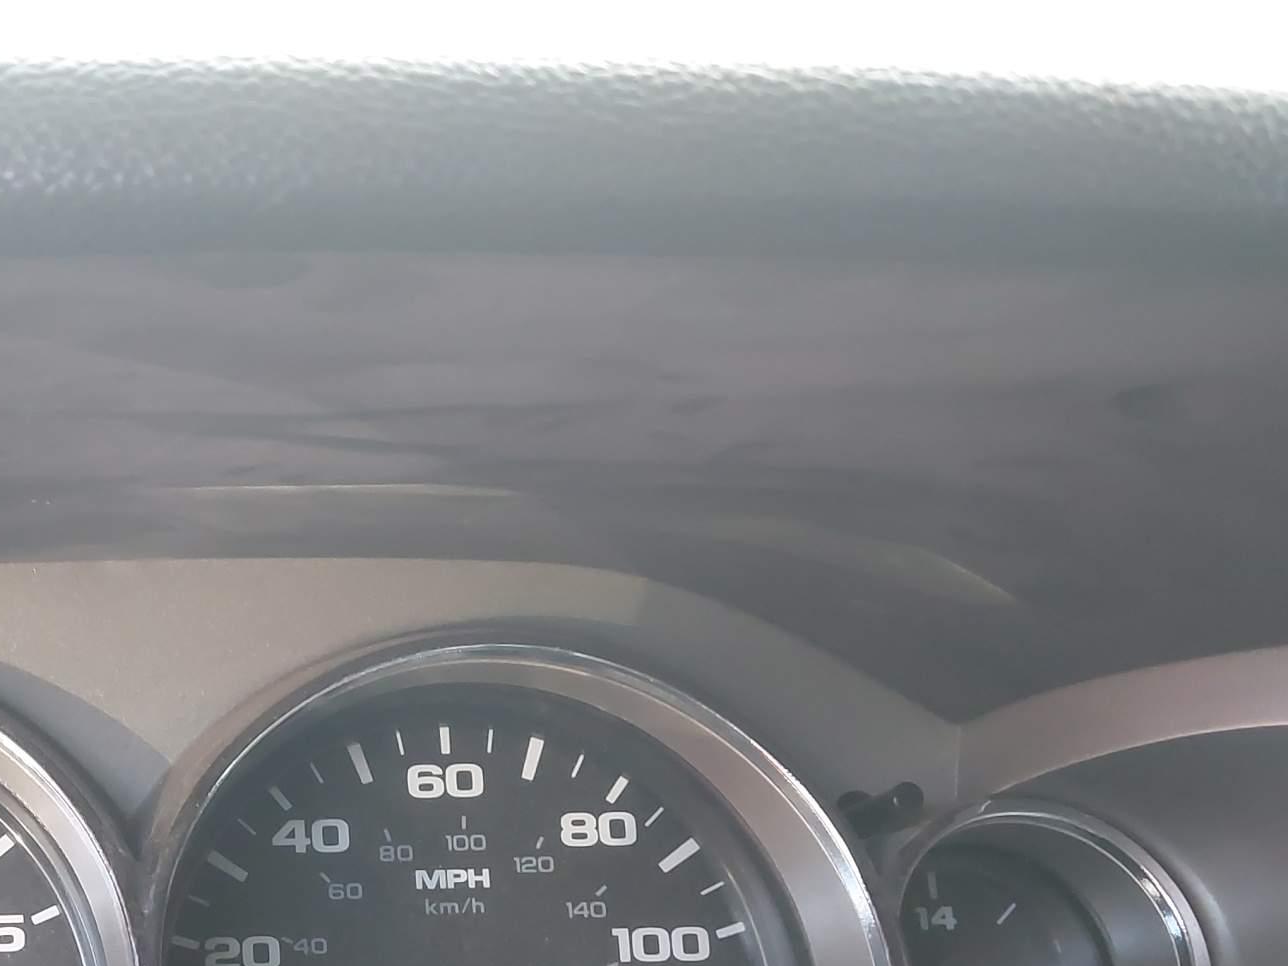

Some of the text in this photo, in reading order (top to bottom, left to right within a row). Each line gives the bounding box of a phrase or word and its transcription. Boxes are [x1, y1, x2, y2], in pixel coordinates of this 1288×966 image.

[407, 763, 484, 799] 60
[272, 818, 350, 853] 40
[560, 811, 637, 847] 80
[445, 834, 487, 851] 100
[379, 845, 414, 862] 80
[513, 856, 554, 873] 120
[415, 868, 491, 890] MPH
[328, 882, 363, 900] 60
[425, 897, 485, 915] km/h
[565, 901, 607, 919] 140
[915, 905, 958, 930] 14
[293, 937, 328, 955] 40
[611, 926, 710, 963] 100
